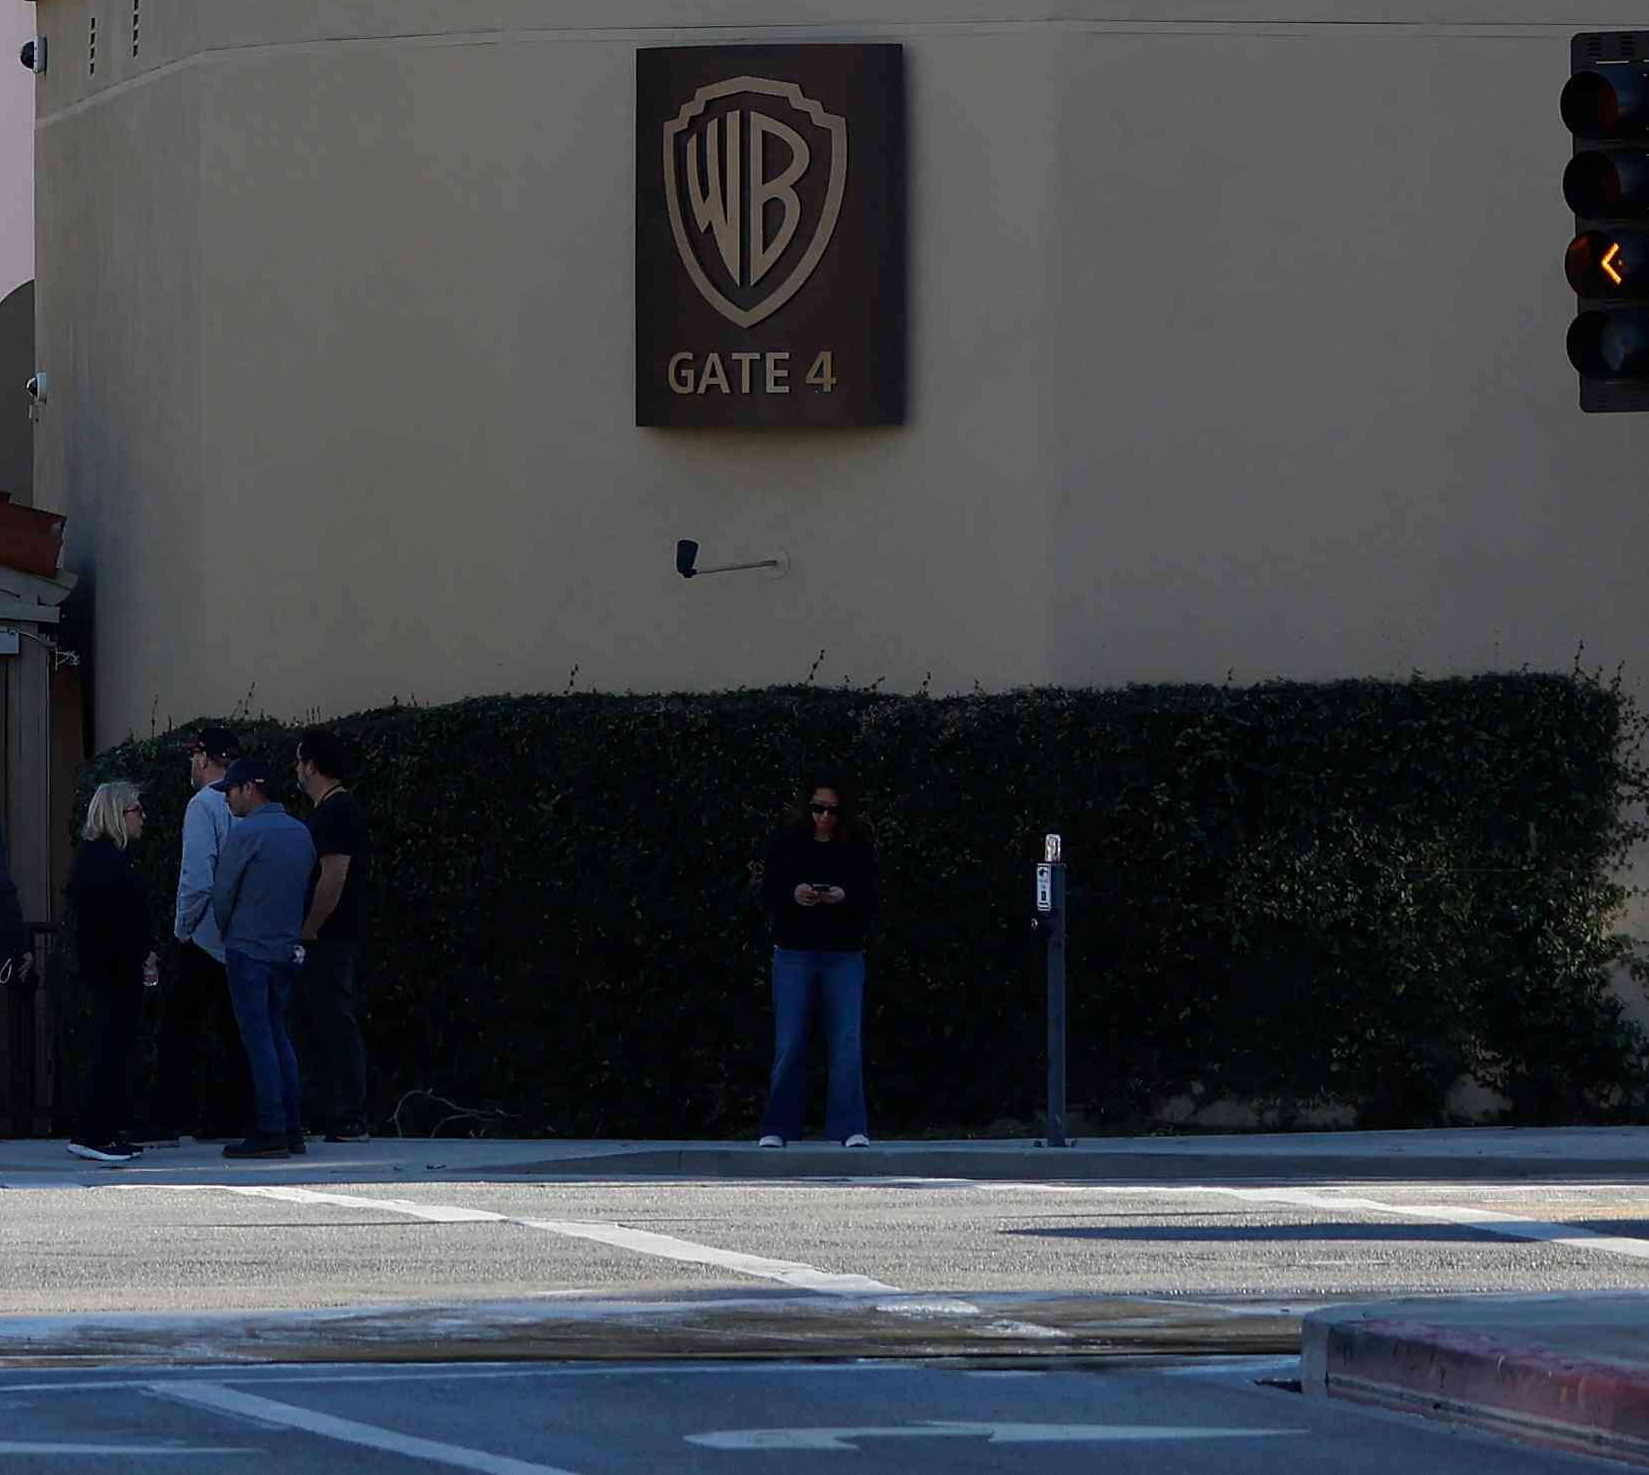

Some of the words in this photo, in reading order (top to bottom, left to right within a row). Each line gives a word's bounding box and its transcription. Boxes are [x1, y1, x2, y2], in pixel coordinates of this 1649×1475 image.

[686, 109, 811, 287] WB
[667, 351, 790, 394] GATE
[805, 351, 837, 393] 4
